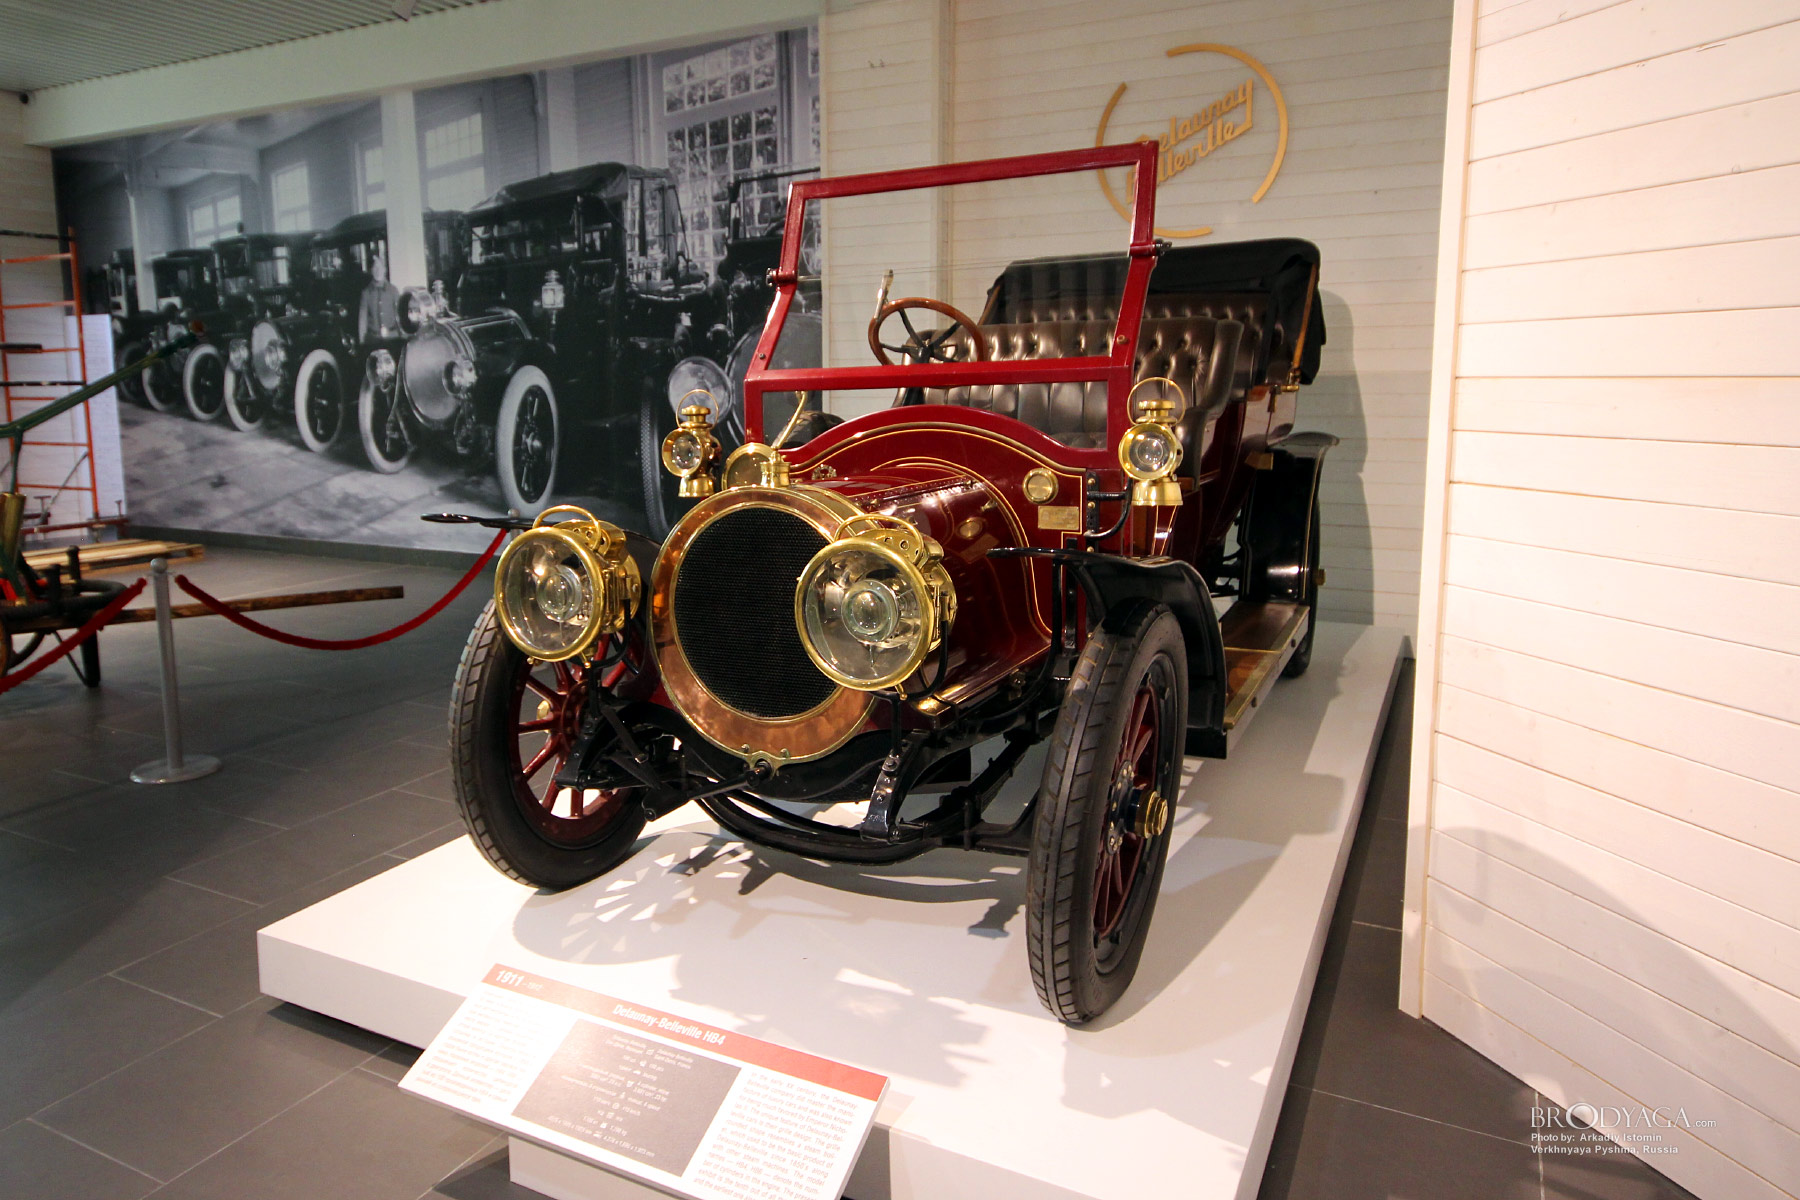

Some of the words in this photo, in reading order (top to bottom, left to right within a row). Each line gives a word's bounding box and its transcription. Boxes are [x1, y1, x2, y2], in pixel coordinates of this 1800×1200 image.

[495, 970, 525, 987] 1911
[612, 1004, 703, 1039] Delaunay-Belleville
[702, 1030, 727, 1046] HB4
[769, 1087, 794, 1099] company
[767, 1095, 784, 1105] luxury
[820, 1111, 833, 1119] also
[833, 1115, 852, 1125] known
[797, 1113, 805, 1121] by
[804, 1116, 829, 1129] Emperor
[766, 1132, 795, 1145] resembles
[803, 1144, 821, 1153] steam
[814, 1137, 825, 1145] The
[825, 1141, 841, 1151] grille
[786, 1148, 802, 1158] basic
[802, 1154, 825, 1167] product
[742, 1153, 760, 1163] steam
[792, 1170, 804, 1178] The
[806, 1175, 825, 1186] model
[811, 1167, 829, 1178] along
[718, 1165, 744, 1179] cylinders
[750, 1176, 761, 1184] the
[782, 1187, 794, 1195] The
[723, 1177, 734, 1185] the
[749, 1186, 760, 1194] out
[793, 1180, 804, 1188] the
